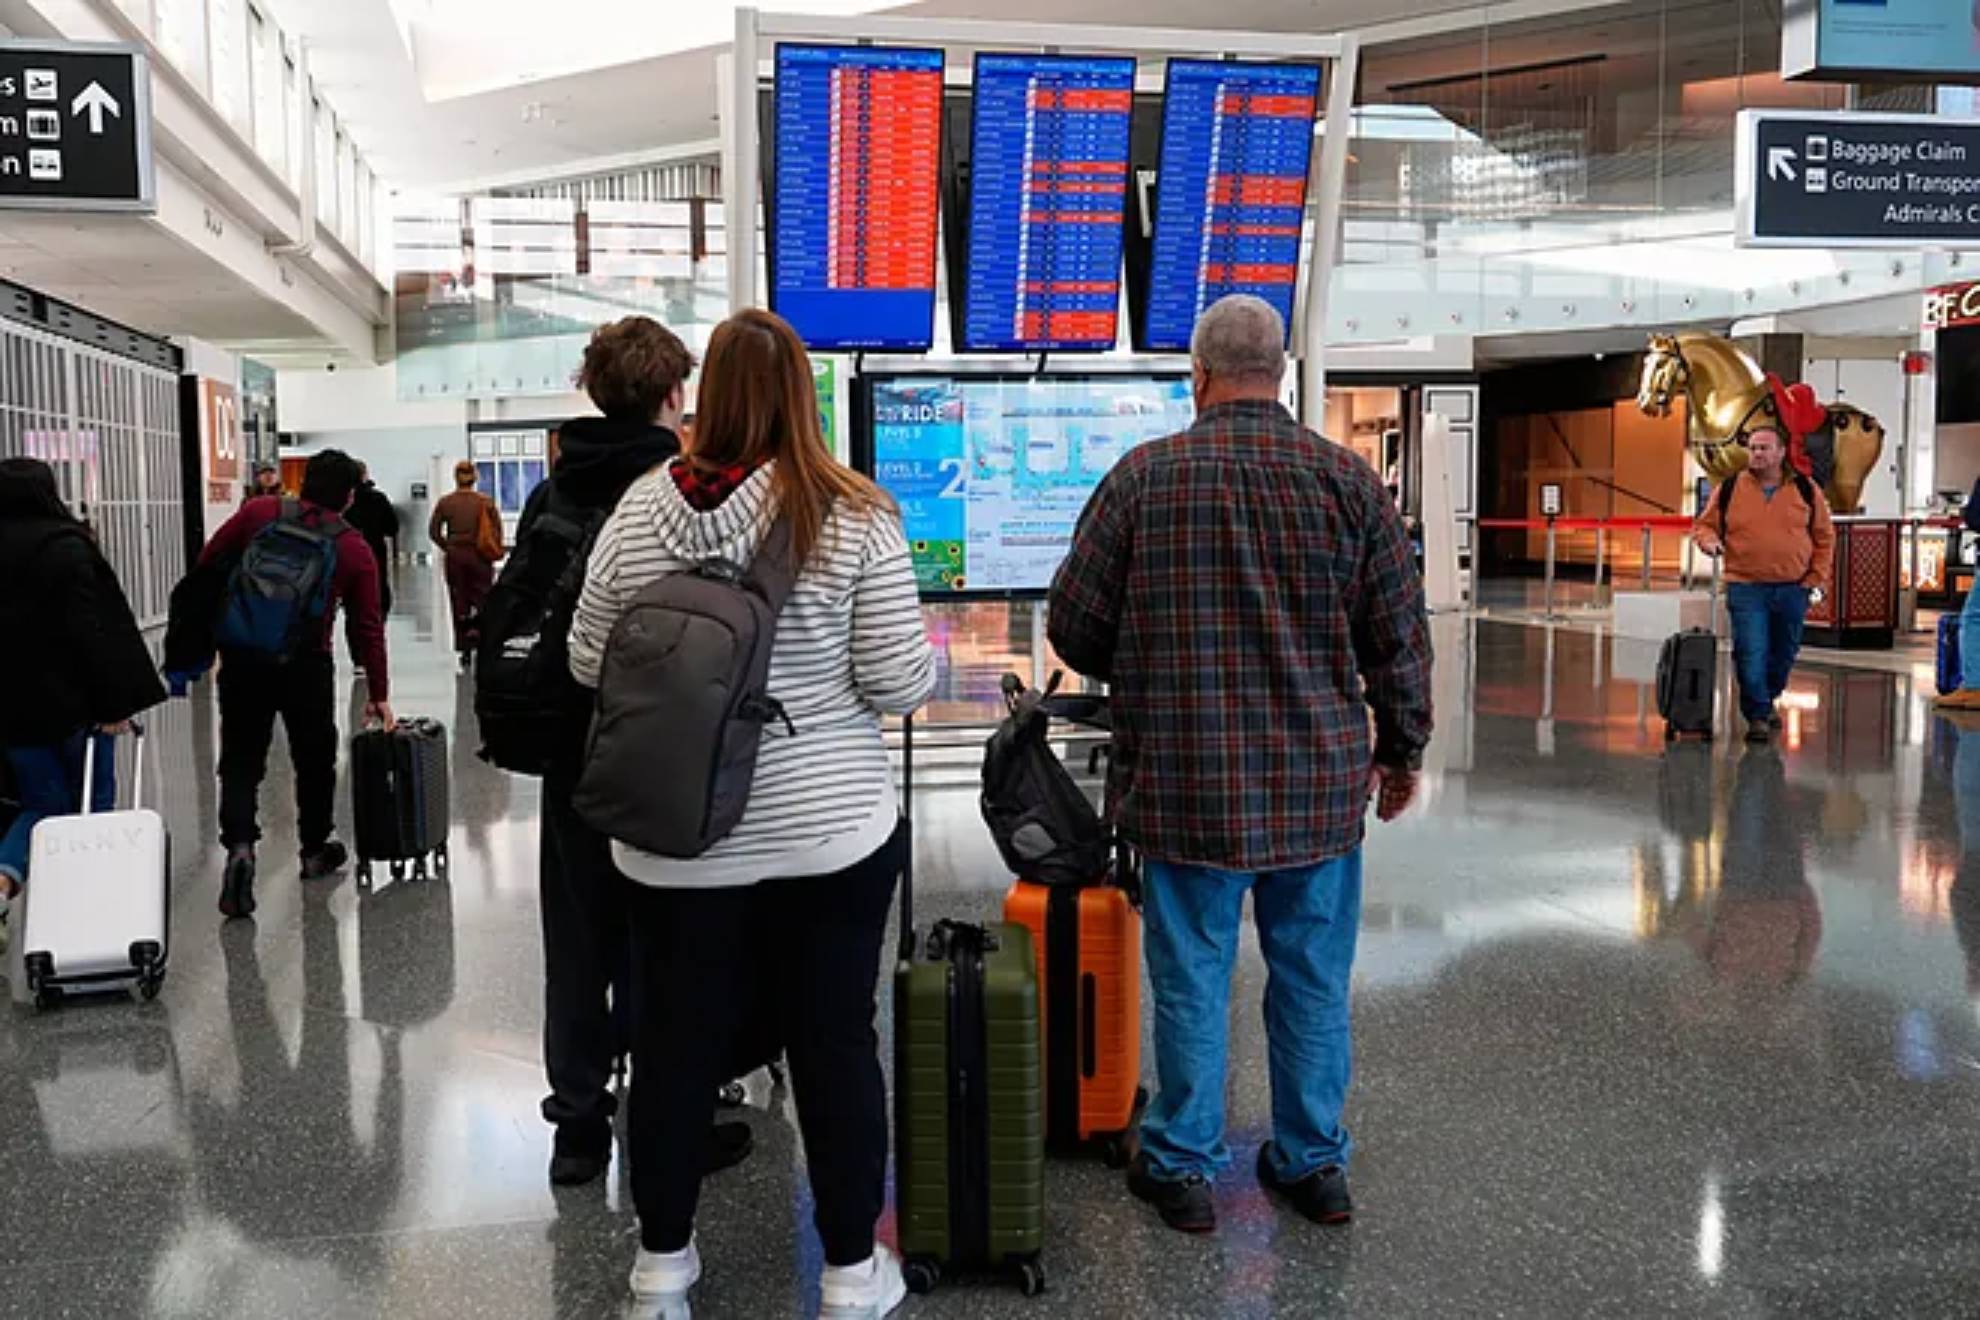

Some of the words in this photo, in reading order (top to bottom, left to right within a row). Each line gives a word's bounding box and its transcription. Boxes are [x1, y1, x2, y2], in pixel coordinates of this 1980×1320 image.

[1832, 140, 1911, 165] Baggage
[1917, 140, 1966, 160] Claim
[1832, 171, 1899, 190] Ground
[1883, 203, 1962, 223] Admirals
[902, 404, 945, 421] RIDE
[938, 459, 970, 499] 2
